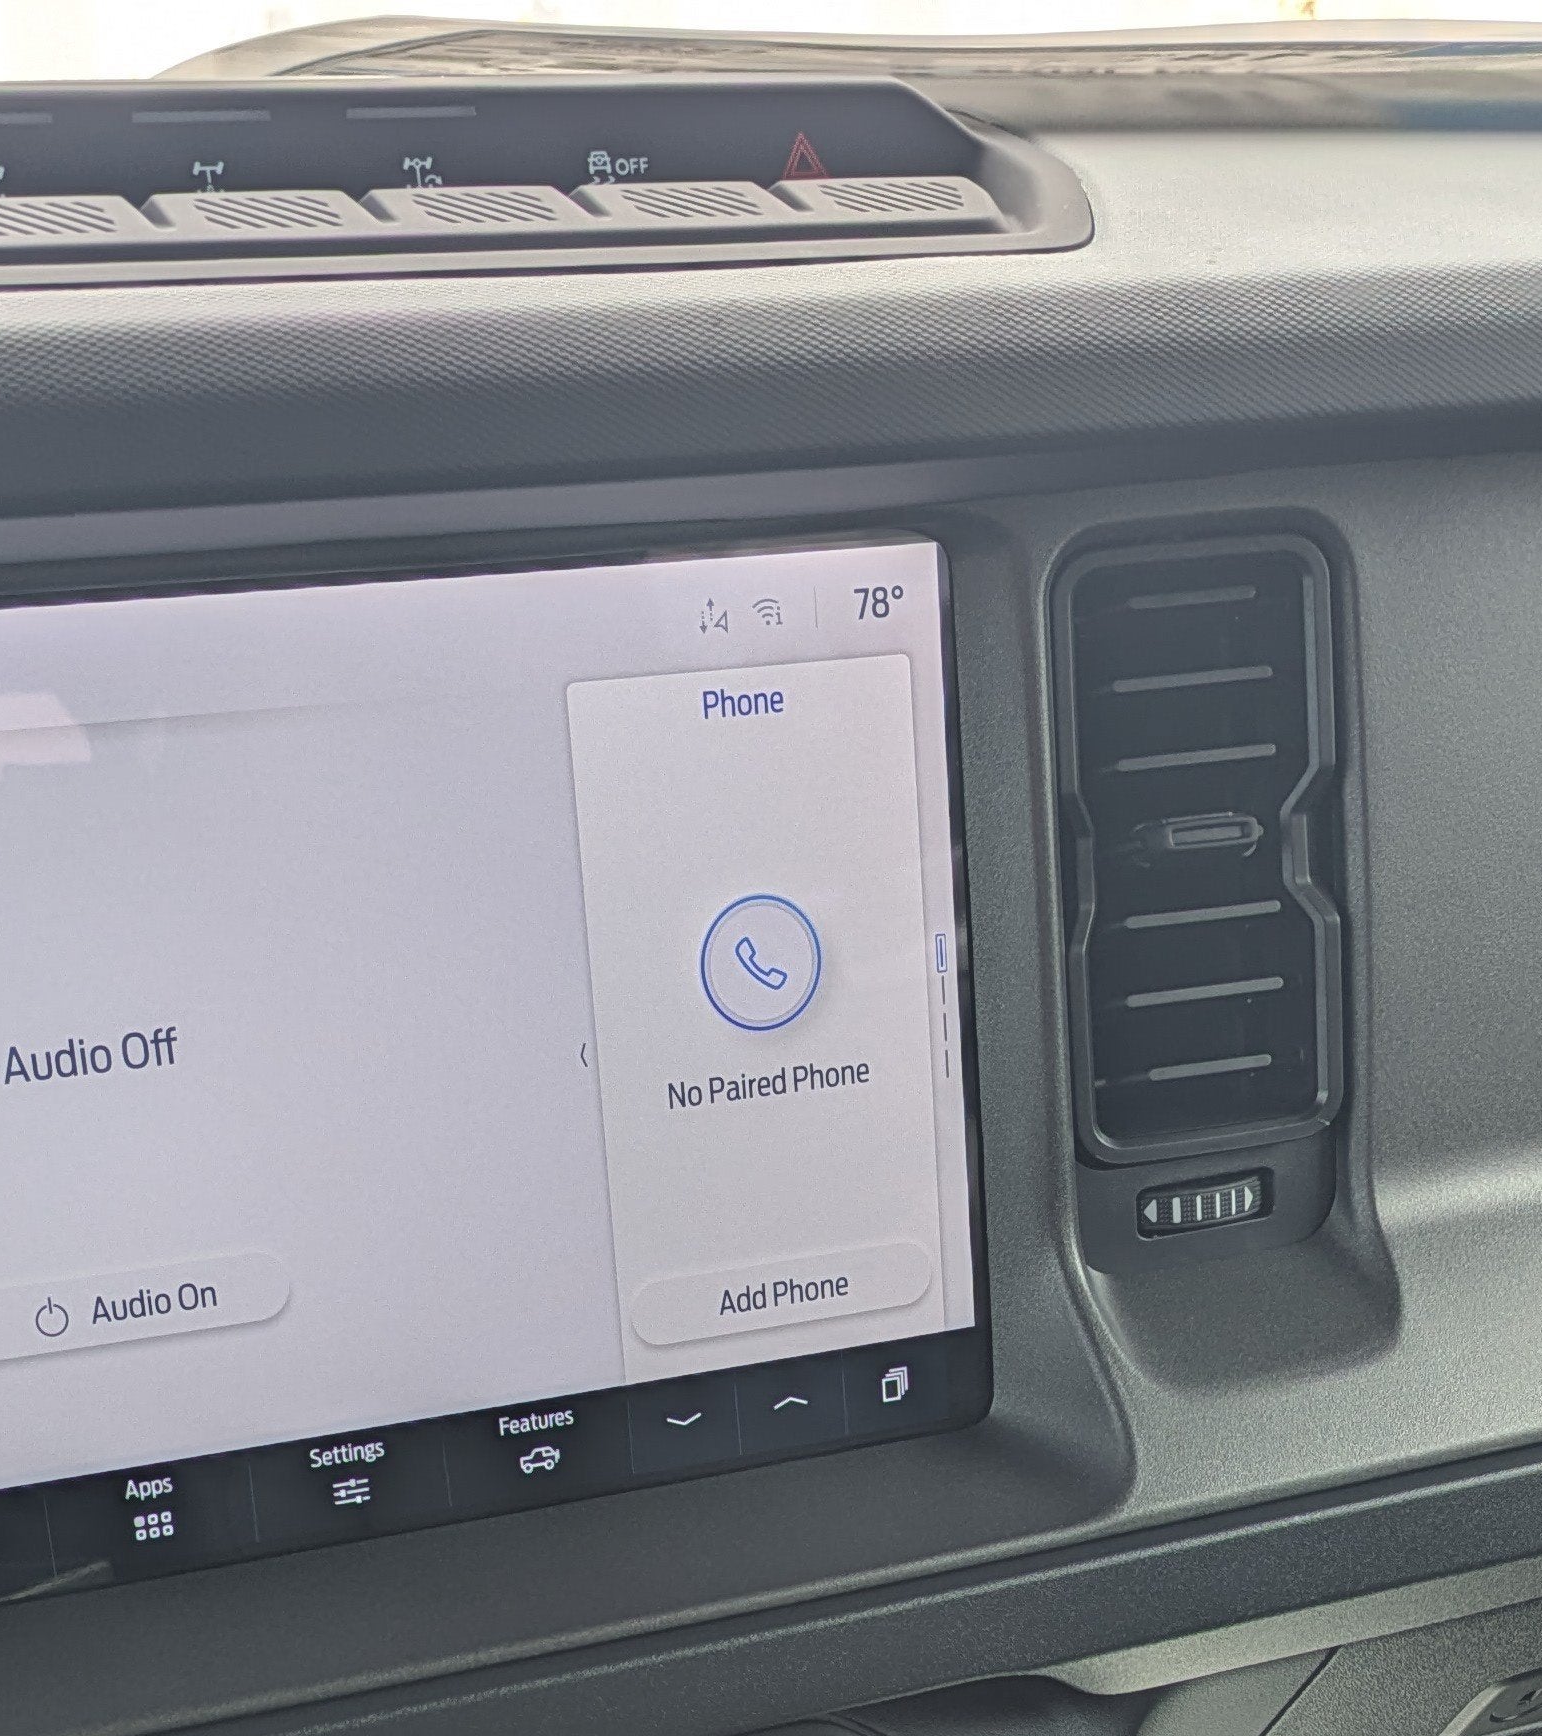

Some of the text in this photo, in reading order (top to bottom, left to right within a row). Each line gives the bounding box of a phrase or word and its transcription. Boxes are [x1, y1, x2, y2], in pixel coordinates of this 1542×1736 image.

[615, 157, 649, 176] OFF
[853, 583, 905, 623] 78°
[702, 685, 786, 721] Phone
[2, 1026, 179, 1086] Audio Off
[667, 1058, 871, 1111] No Paired Phone
[91, 1281, 219, 1326] Audio On
[719, 1271, 850, 1317] Add Phone
[498, 1406, 575, 1439] Features
[308, 1438, 386, 1471] Settings
[124, 1473, 174, 1503] Apps
